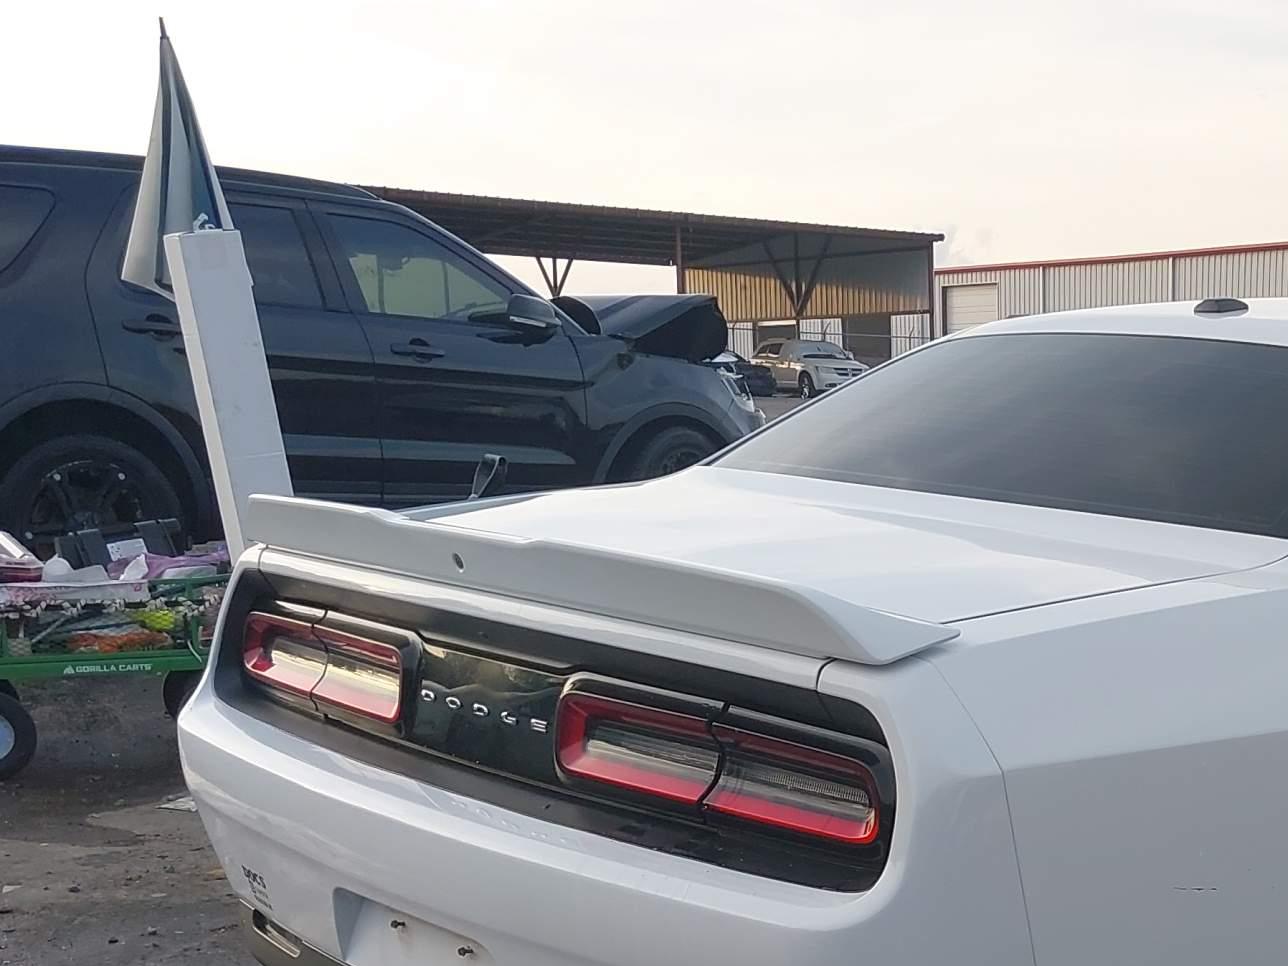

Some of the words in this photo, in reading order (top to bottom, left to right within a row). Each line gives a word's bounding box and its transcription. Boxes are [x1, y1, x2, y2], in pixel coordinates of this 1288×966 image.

[76, 665, 117, 673] GORILLA
[119, 663, 152, 672] CARTS
[421, 688, 548, 733] DODGE
